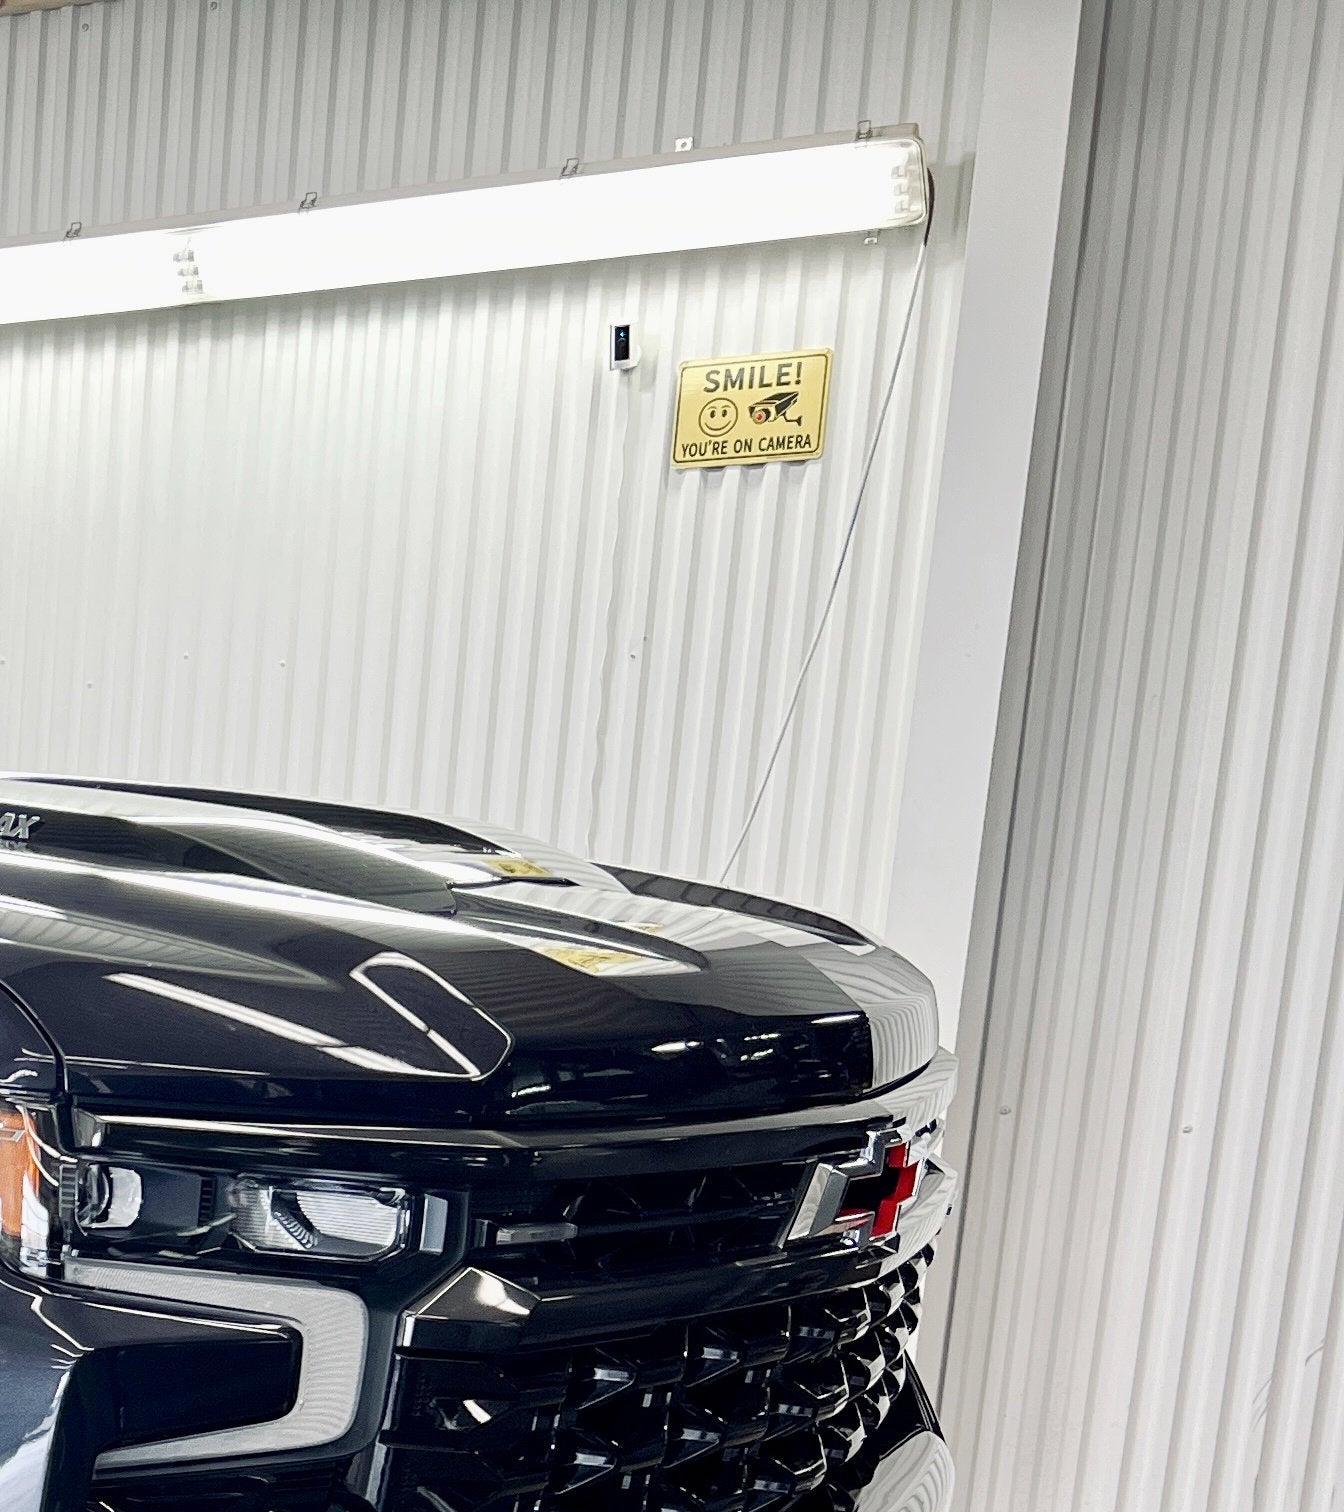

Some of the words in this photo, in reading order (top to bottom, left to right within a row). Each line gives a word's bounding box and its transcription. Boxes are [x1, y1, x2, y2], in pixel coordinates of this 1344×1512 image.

[703, 361, 803, 394] SMILE!
[681, 439, 729, 459] YOU'RE
[734, 437, 753, 453] ON
[758, 433, 812, 452] CAMERA
